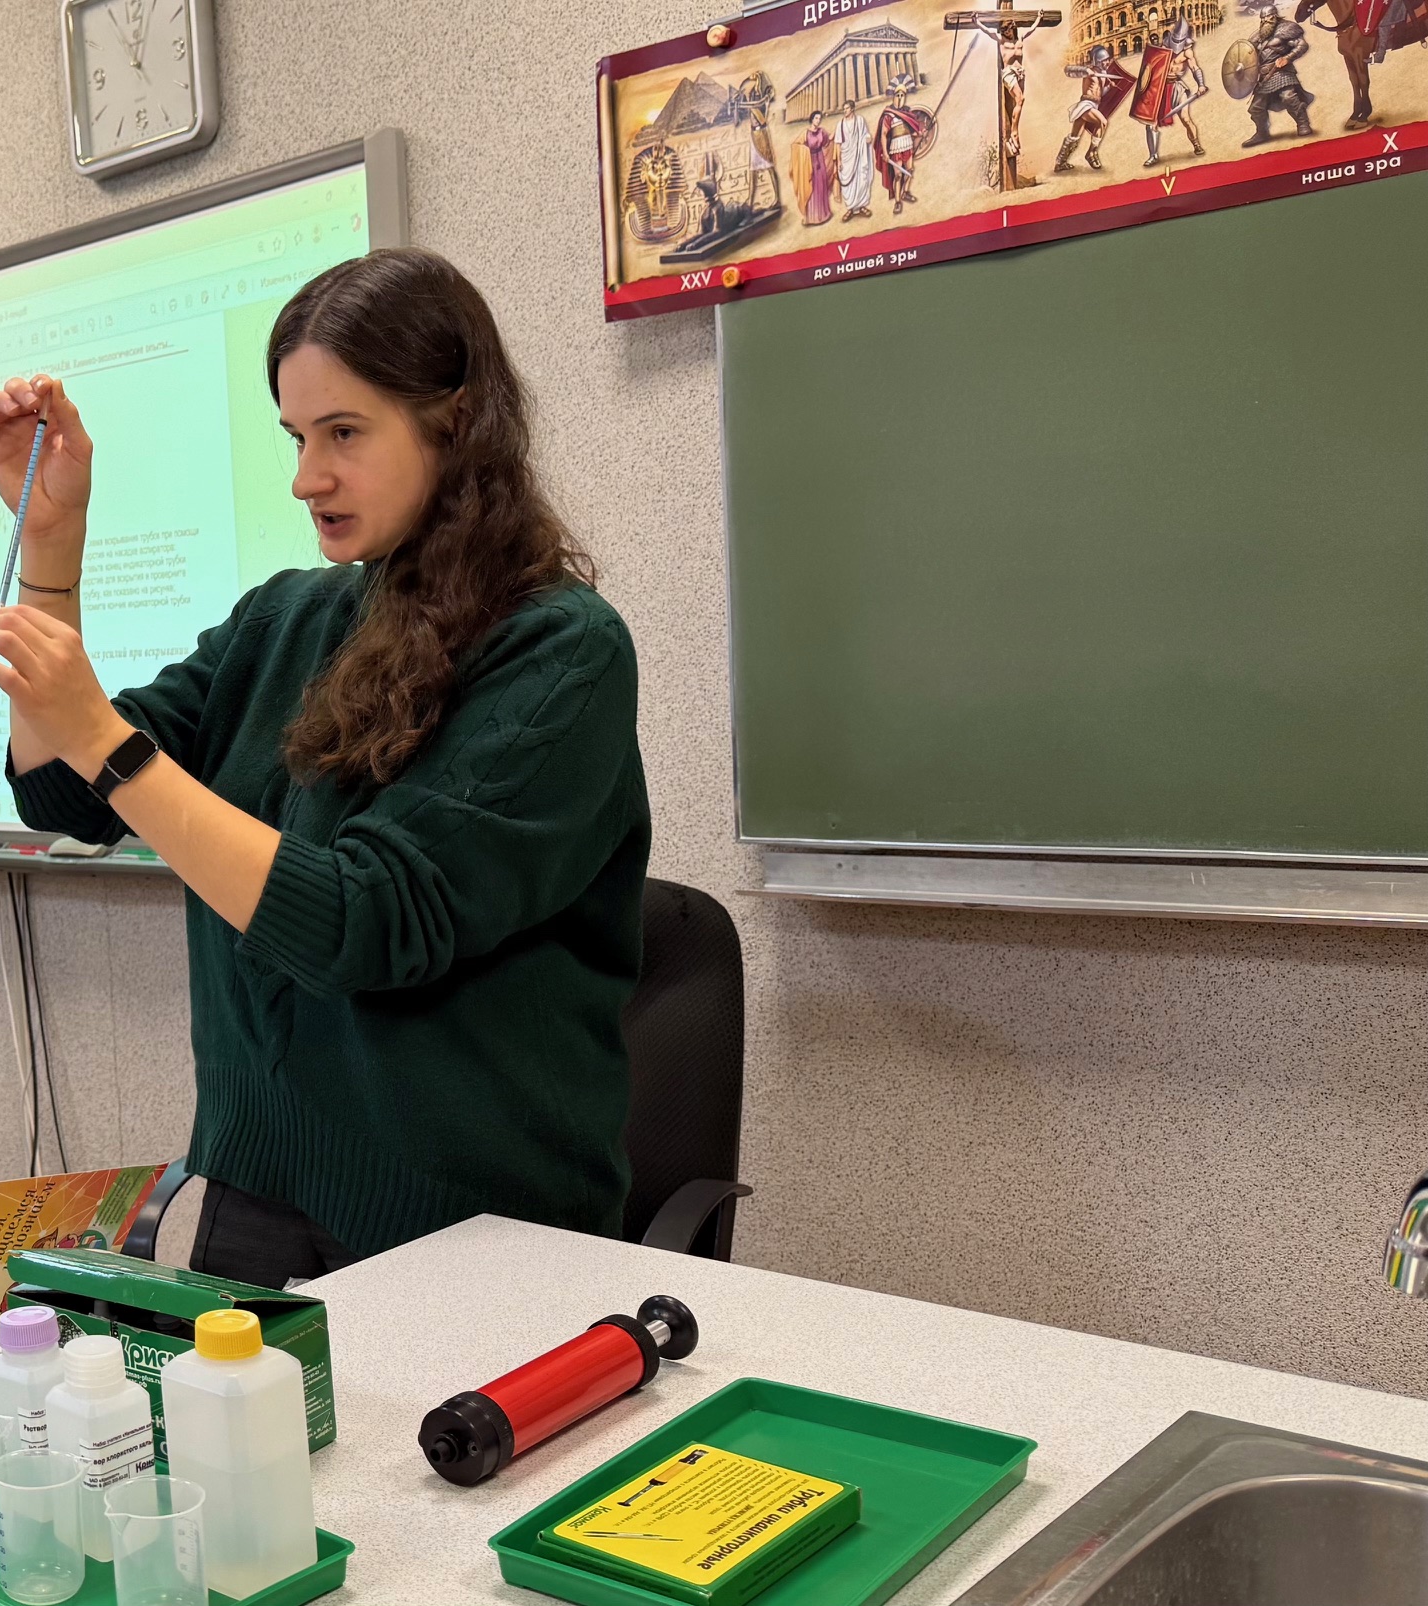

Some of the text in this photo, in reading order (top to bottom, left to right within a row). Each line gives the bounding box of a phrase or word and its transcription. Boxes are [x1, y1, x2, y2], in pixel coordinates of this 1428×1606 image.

[1382, 131, 1399, 153] X
[1301, 155, 1401, 184] наша эра
[1160, 176, 1176, 196] V
[837, 243, 851, 260] V
[813, 250, 918, 280] до нашей эры
[680, 270, 713, 290] XXV
[120, 1333, 175, 1368] Крис
[23, 1424, 47, 1433] Раствор
[106, 1444, 138, 1462] хлористого
[776, 1489, 824, 1513] Трубки
[567, 1505, 611, 1528] Крисмас
[697, 1513, 781, 1569] индикаторные
